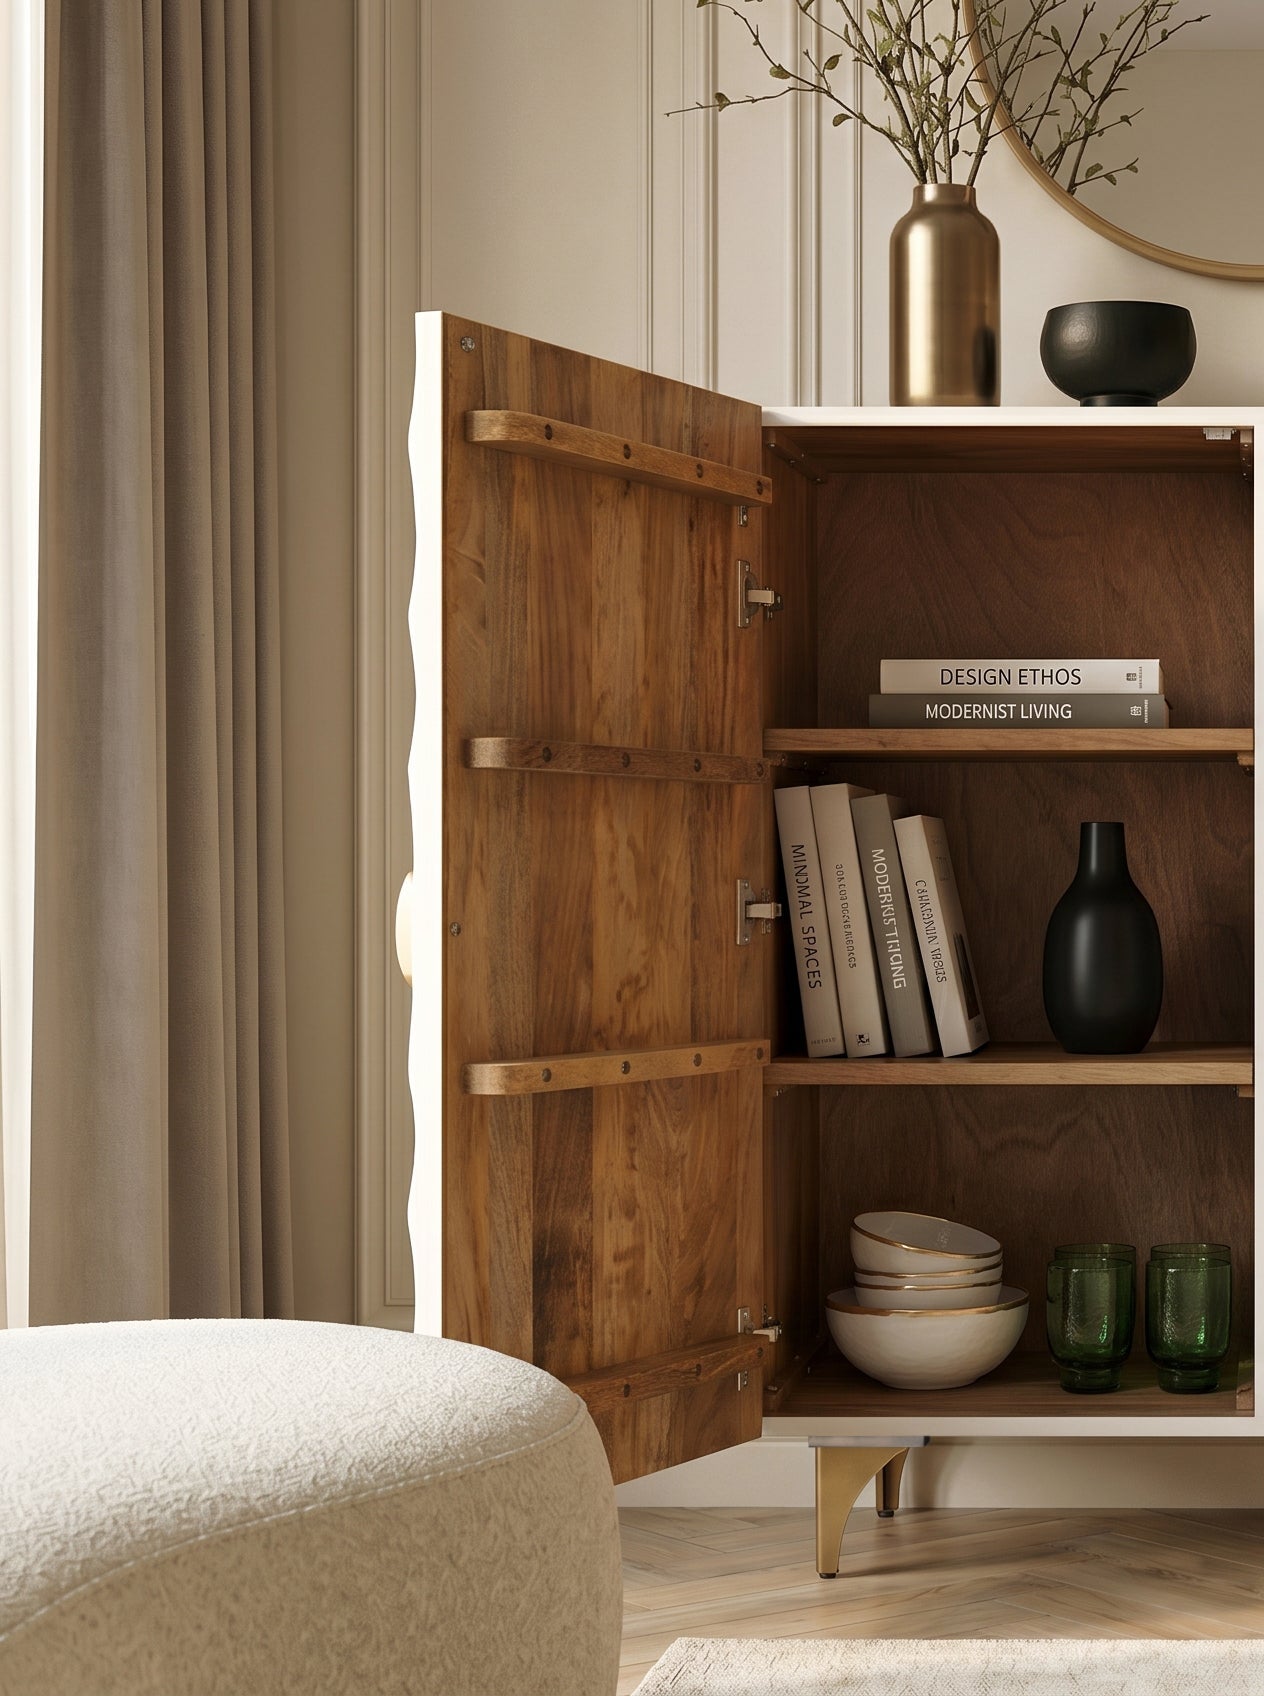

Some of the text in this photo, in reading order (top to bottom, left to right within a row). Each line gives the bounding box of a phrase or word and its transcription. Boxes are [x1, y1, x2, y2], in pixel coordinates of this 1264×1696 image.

[940, 668, 1082, 686] DESIGN ETHOS
[925, 703, 1072, 719] MODERNIST LIVING
[801, 925, 822, 989] SPACES
